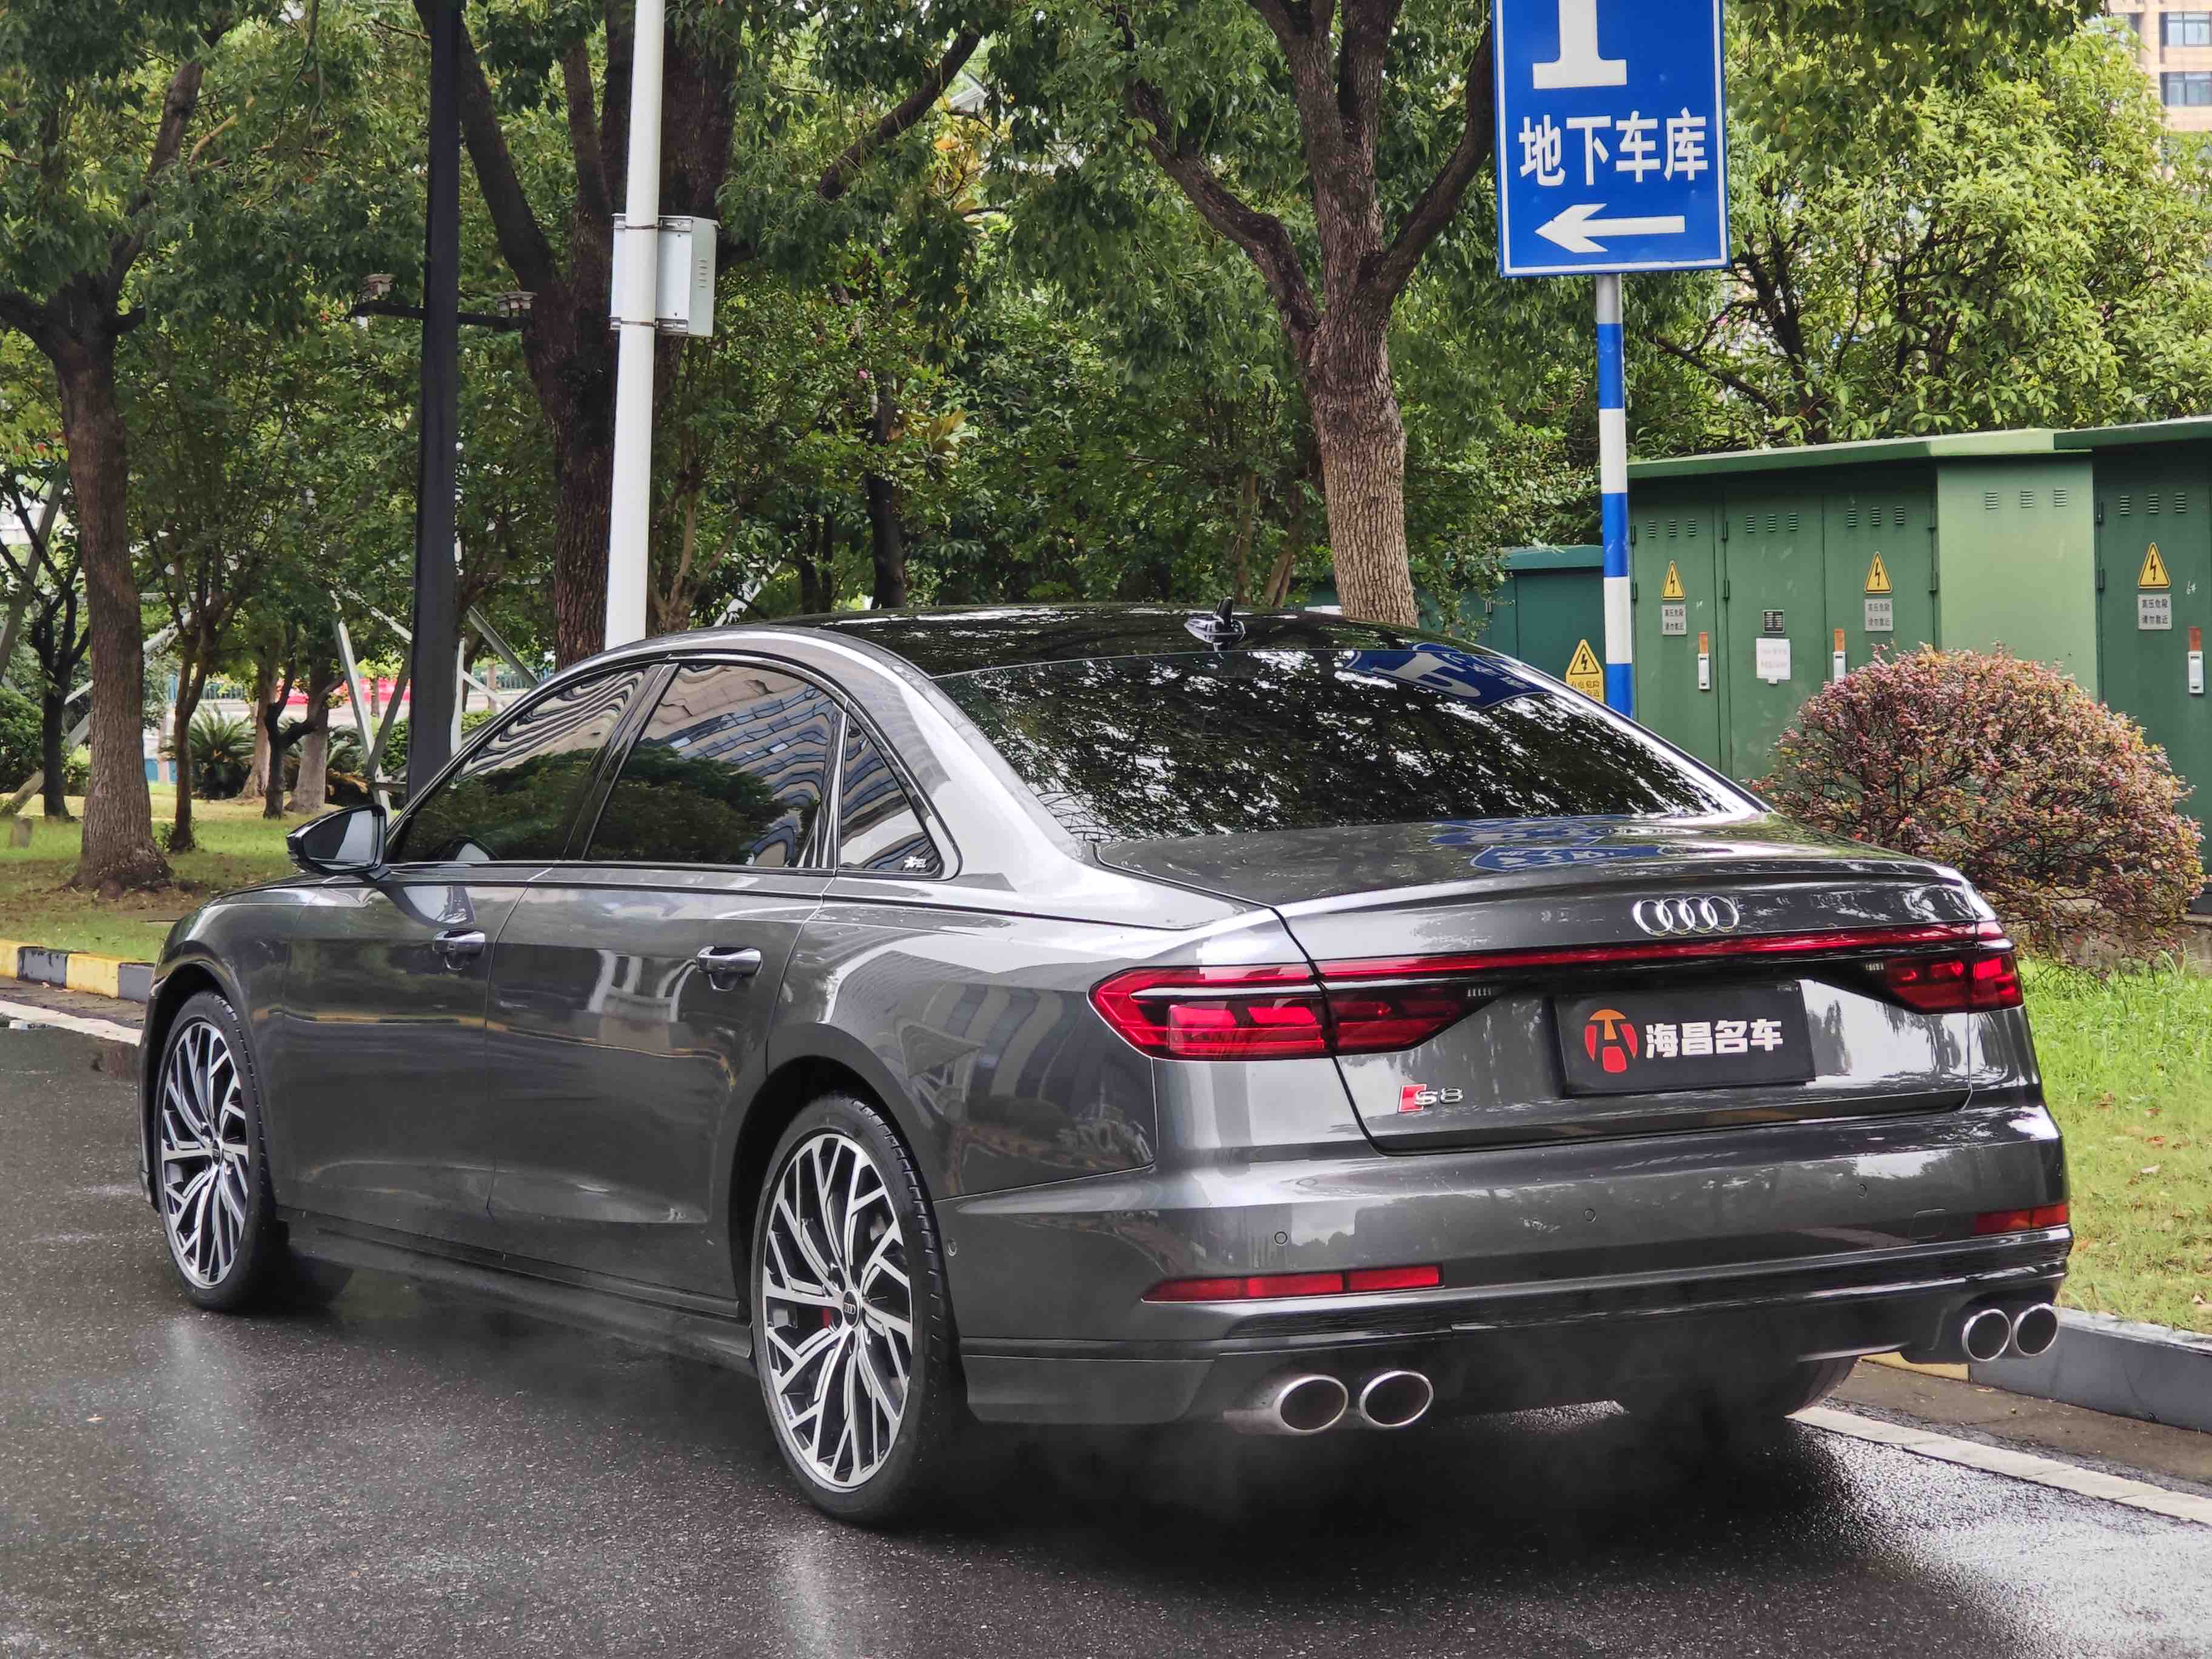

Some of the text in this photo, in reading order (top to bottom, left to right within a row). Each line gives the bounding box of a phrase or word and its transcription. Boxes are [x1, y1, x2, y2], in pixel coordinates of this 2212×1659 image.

[1518, 107, 1708, 187] 地下车库
[1644, 1018, 1784, 1059] 海昌名车
[1413, 1088, 1464, 1106] S8
